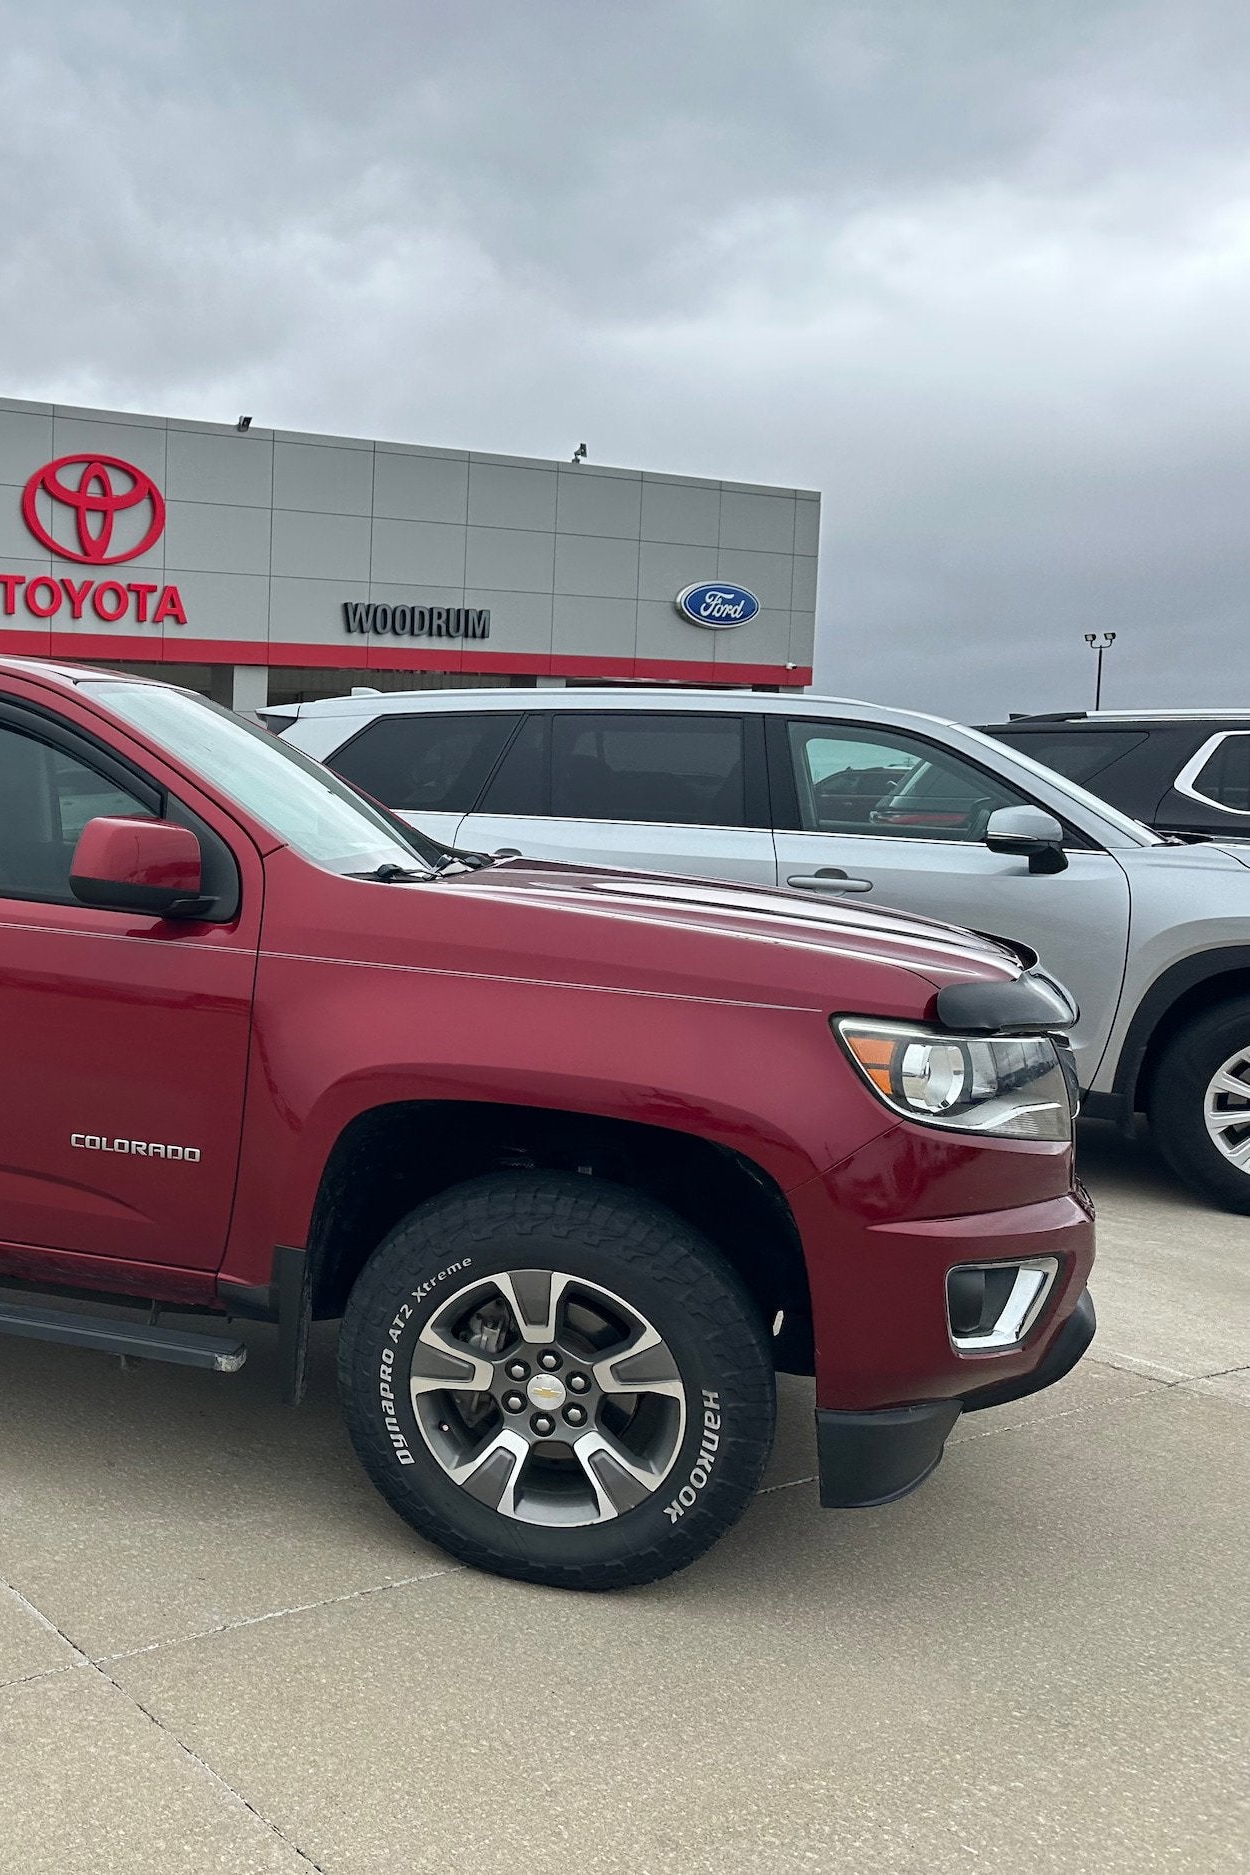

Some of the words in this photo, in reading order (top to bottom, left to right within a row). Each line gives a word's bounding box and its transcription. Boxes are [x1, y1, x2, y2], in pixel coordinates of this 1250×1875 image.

[343, 601, 490, 638] WOODRUM
[700, 591, 745, 618] Ford
[70, 1133, 201, 1163] COLORADO
[388, 1303, 413, 1344] AT2
[411, 1257, 473, 1303] Xtreme
